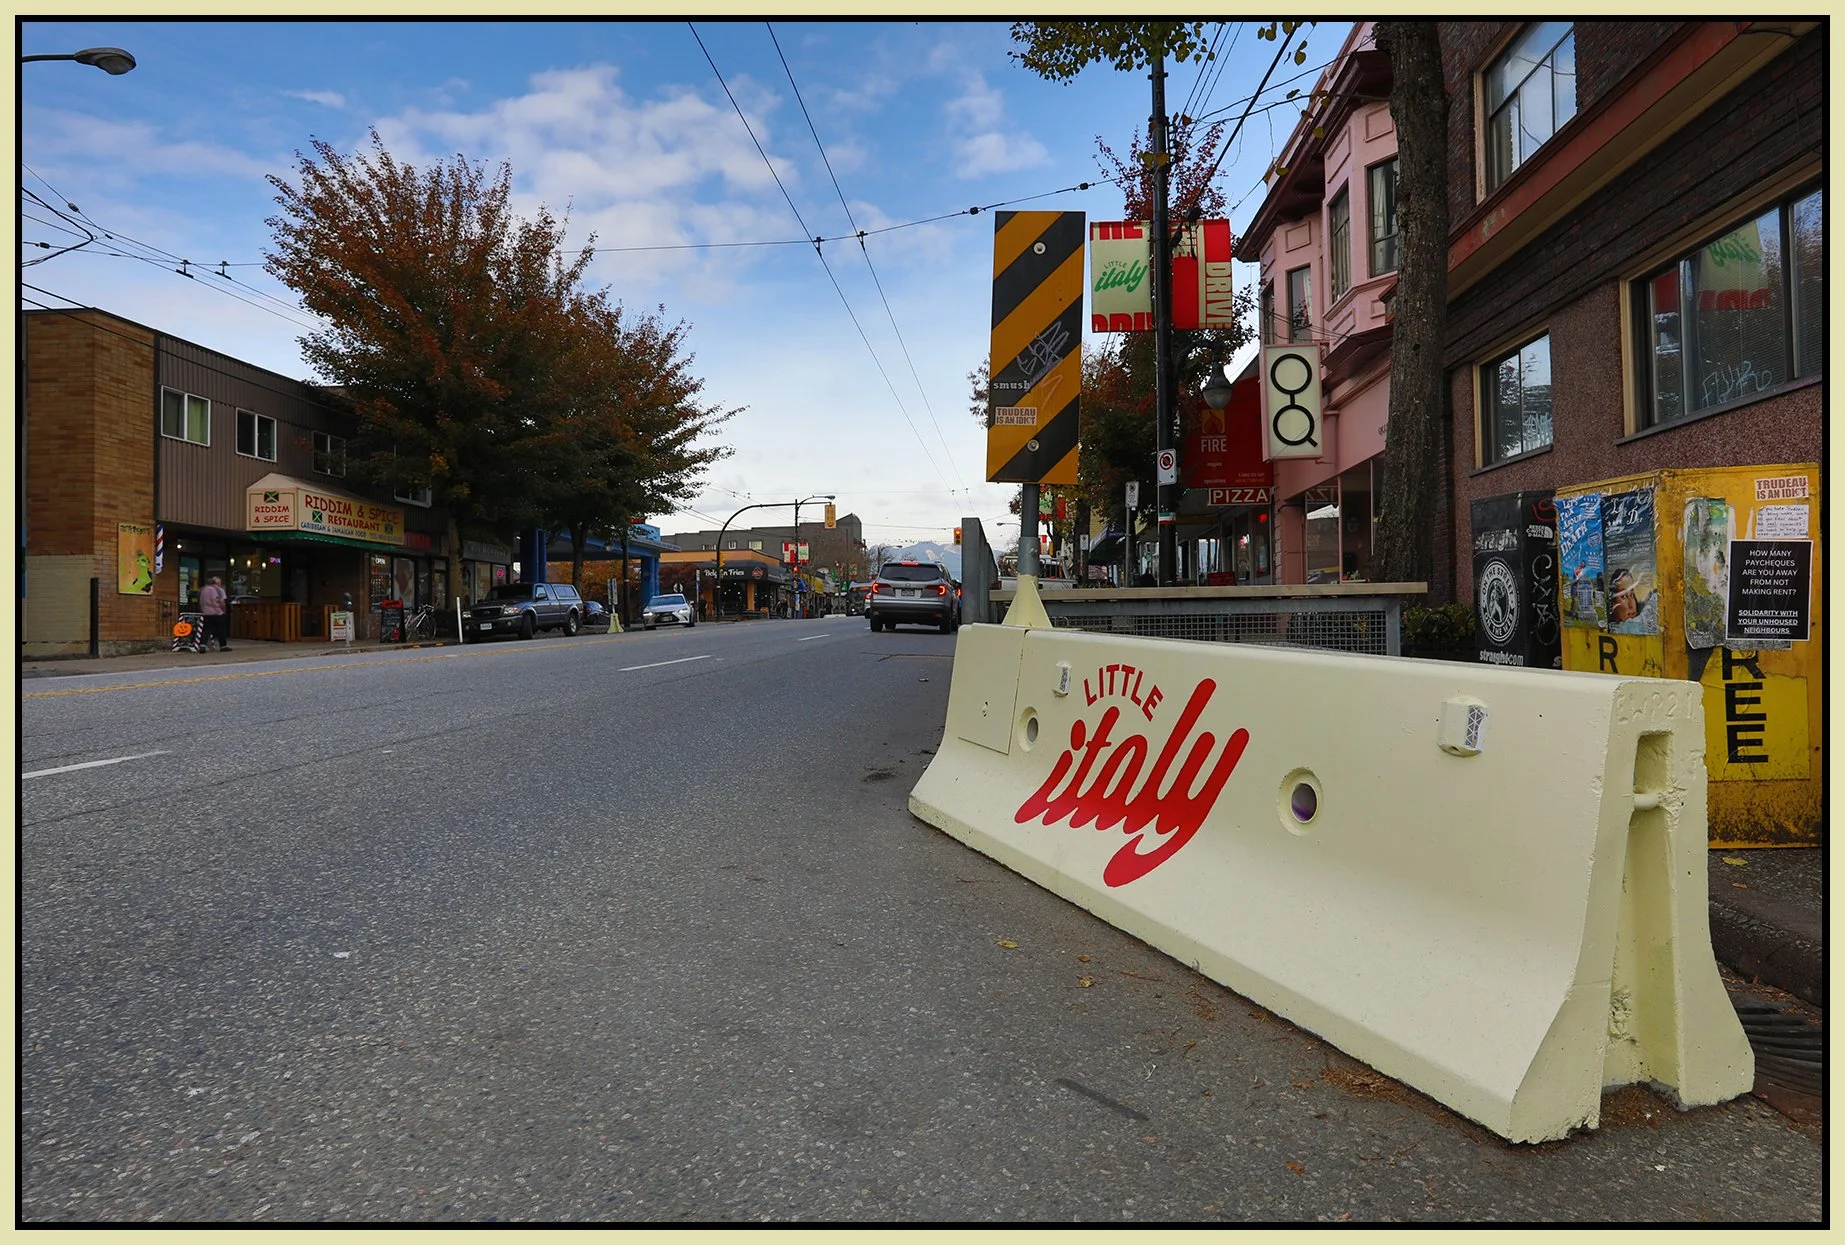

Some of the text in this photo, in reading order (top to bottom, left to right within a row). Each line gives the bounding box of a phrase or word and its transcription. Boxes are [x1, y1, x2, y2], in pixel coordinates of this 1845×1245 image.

[1104, 260, 1127, 270] LITTLE
[1094, 259, 1149, 293] italy
[993, 380, 1031, 390] smush
[996, 407, 1036, 417] TRUDEAU
[996, 417, 1004, 425] IS
[1004, 417, 1015, 425] AN
[1201, 439, 1227, 453] FIRE
[1756, 477, 1807, 490] TRUDEAU
[1213, 489, 1269, 504] PIZZA
[1757, 490, 1766, 500] IS
[1768, 489, 1780, 499] AN
[254, 505, 290, 513] RIDDIM
[305, 494, 400, 525] RIDDIM & SPICE
[264, 515, 290, 523] SPICE
[328, 514, 381, 532] RESTAURANT
[300, 522, 326, 532] CARIBBEAN
[332, 526, 354, 537] JAMAICAN
[355, 529, 366, 538] FOOD
[1560, 521, 1588, 557] DEATH
[728, 568, 744, 576] Fries
[1084, 664, 1164, 722] LITTLE
[1014, 678, 1250, 888] italy
